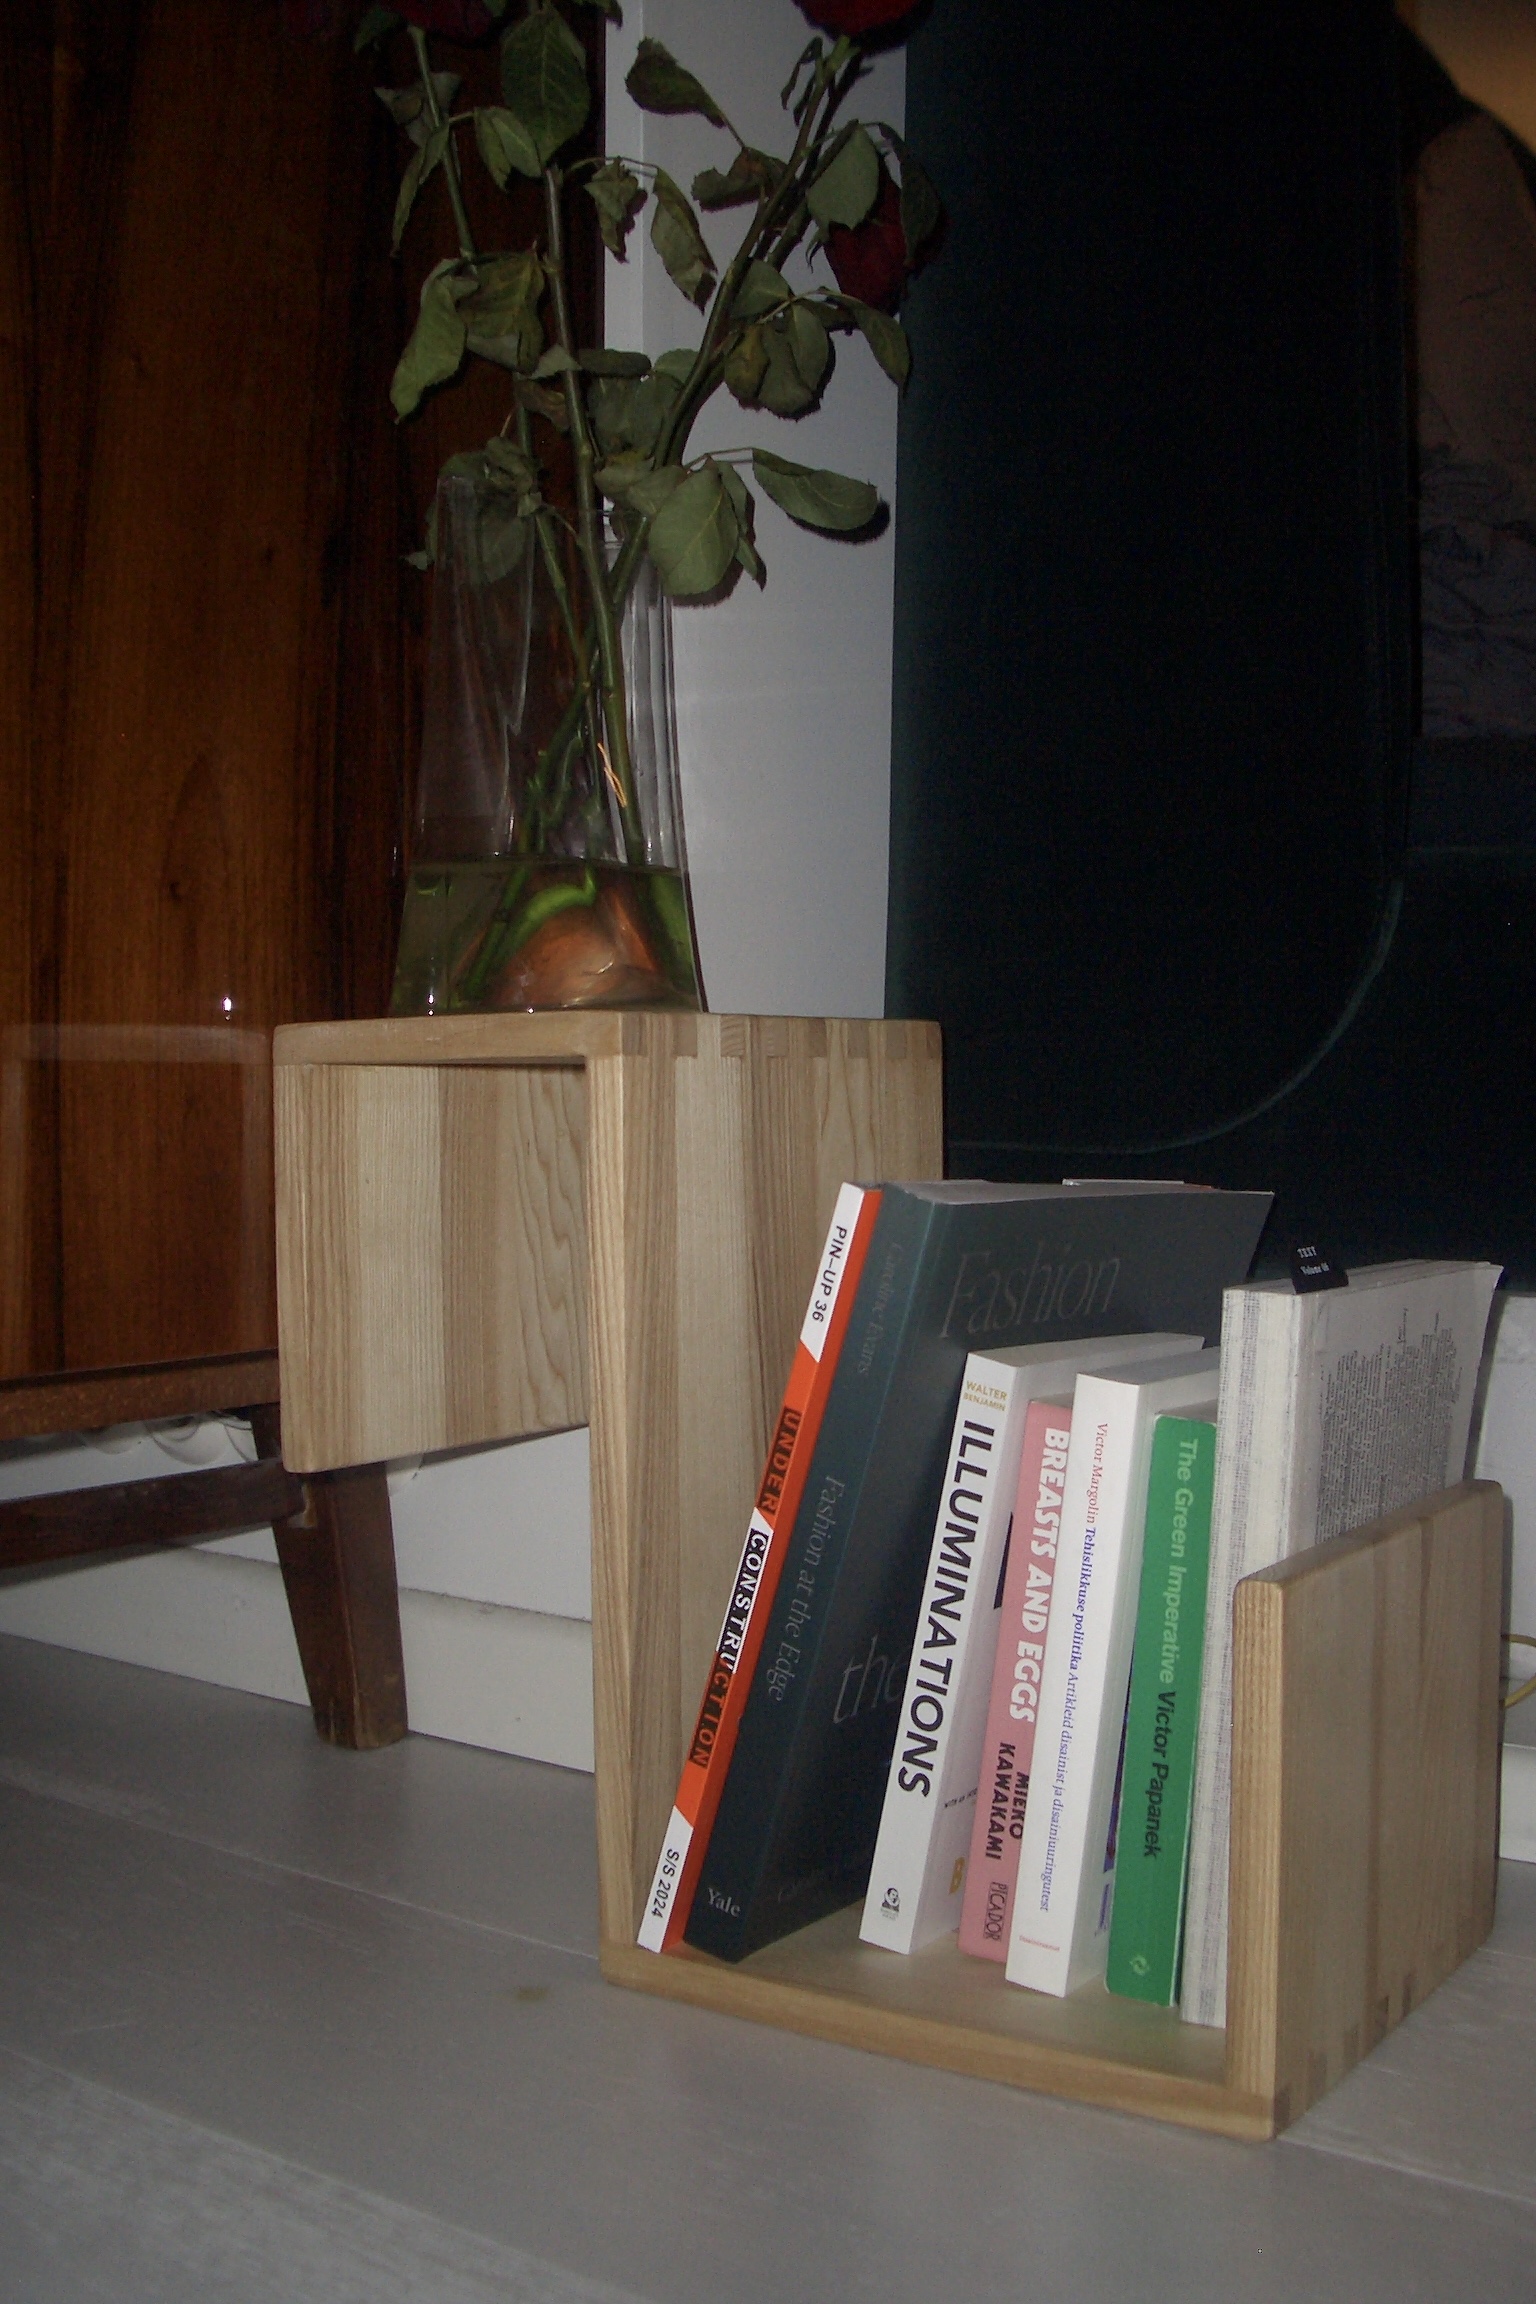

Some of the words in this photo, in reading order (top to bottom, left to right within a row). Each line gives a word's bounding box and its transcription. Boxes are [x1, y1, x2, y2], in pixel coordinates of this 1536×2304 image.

[821, 1226, 847, 1296] PIN-UP
[940, 1240, 1120, 1339] Fashion
[812, 1299, 828, 1323] 36
[966, 1380, 1007, 1401] WALTER
[757, 1408, 801, 1515] UNDER
[1092, 1423, 1107, 1462] Victor
[1177, 1438, 1198, 1481] The
[808, 1474, 846, 1565] Fashion
[1030, 1427, 1070, 1561] BREASTS
[1086, 1464, 1102, 1523] Margolin
[1170, 1485, 1194, 1558] Green
[796, 1568, 814, 1596] at
[1021, 1564, 1053, 1633] AND
[1076, 1527, 1096, 1612] Tehislikkuse
[783, 1598, 810, 1638] the
[898, 1419, 995, 1797] ILLUMINATIONS
[1159, 1566, 1189, 1684] Imperative
[693, 1529, 769, 1767] CONSTRUCTION
[766, 1641, 800, 1701] Edge
[1069, 1613, 1084, 1669] poliitika
[1010, 1640, 1043, 1722] EGGS
[1062, 1672, 1078, 1728] Artikleid
[1152, 1690, 1176, 1757] Victor
[1054, 1729, 1071, 1783] disainist
[985, 1742, 1016, 1861] KAWAKAMI
[1009, 1771, 1030, 1840] MIEKO
[1052, 1784, 1065, 1795] ja
[1143, 1760, 1170, 1858] Papanek
[664, 1849, 680, 1877] S/S
[652, 1879, 672, 1919] 2024
[706, 1887, 741, 1918] Yale
[985, 1881, 1008, 1941] PICADOR
